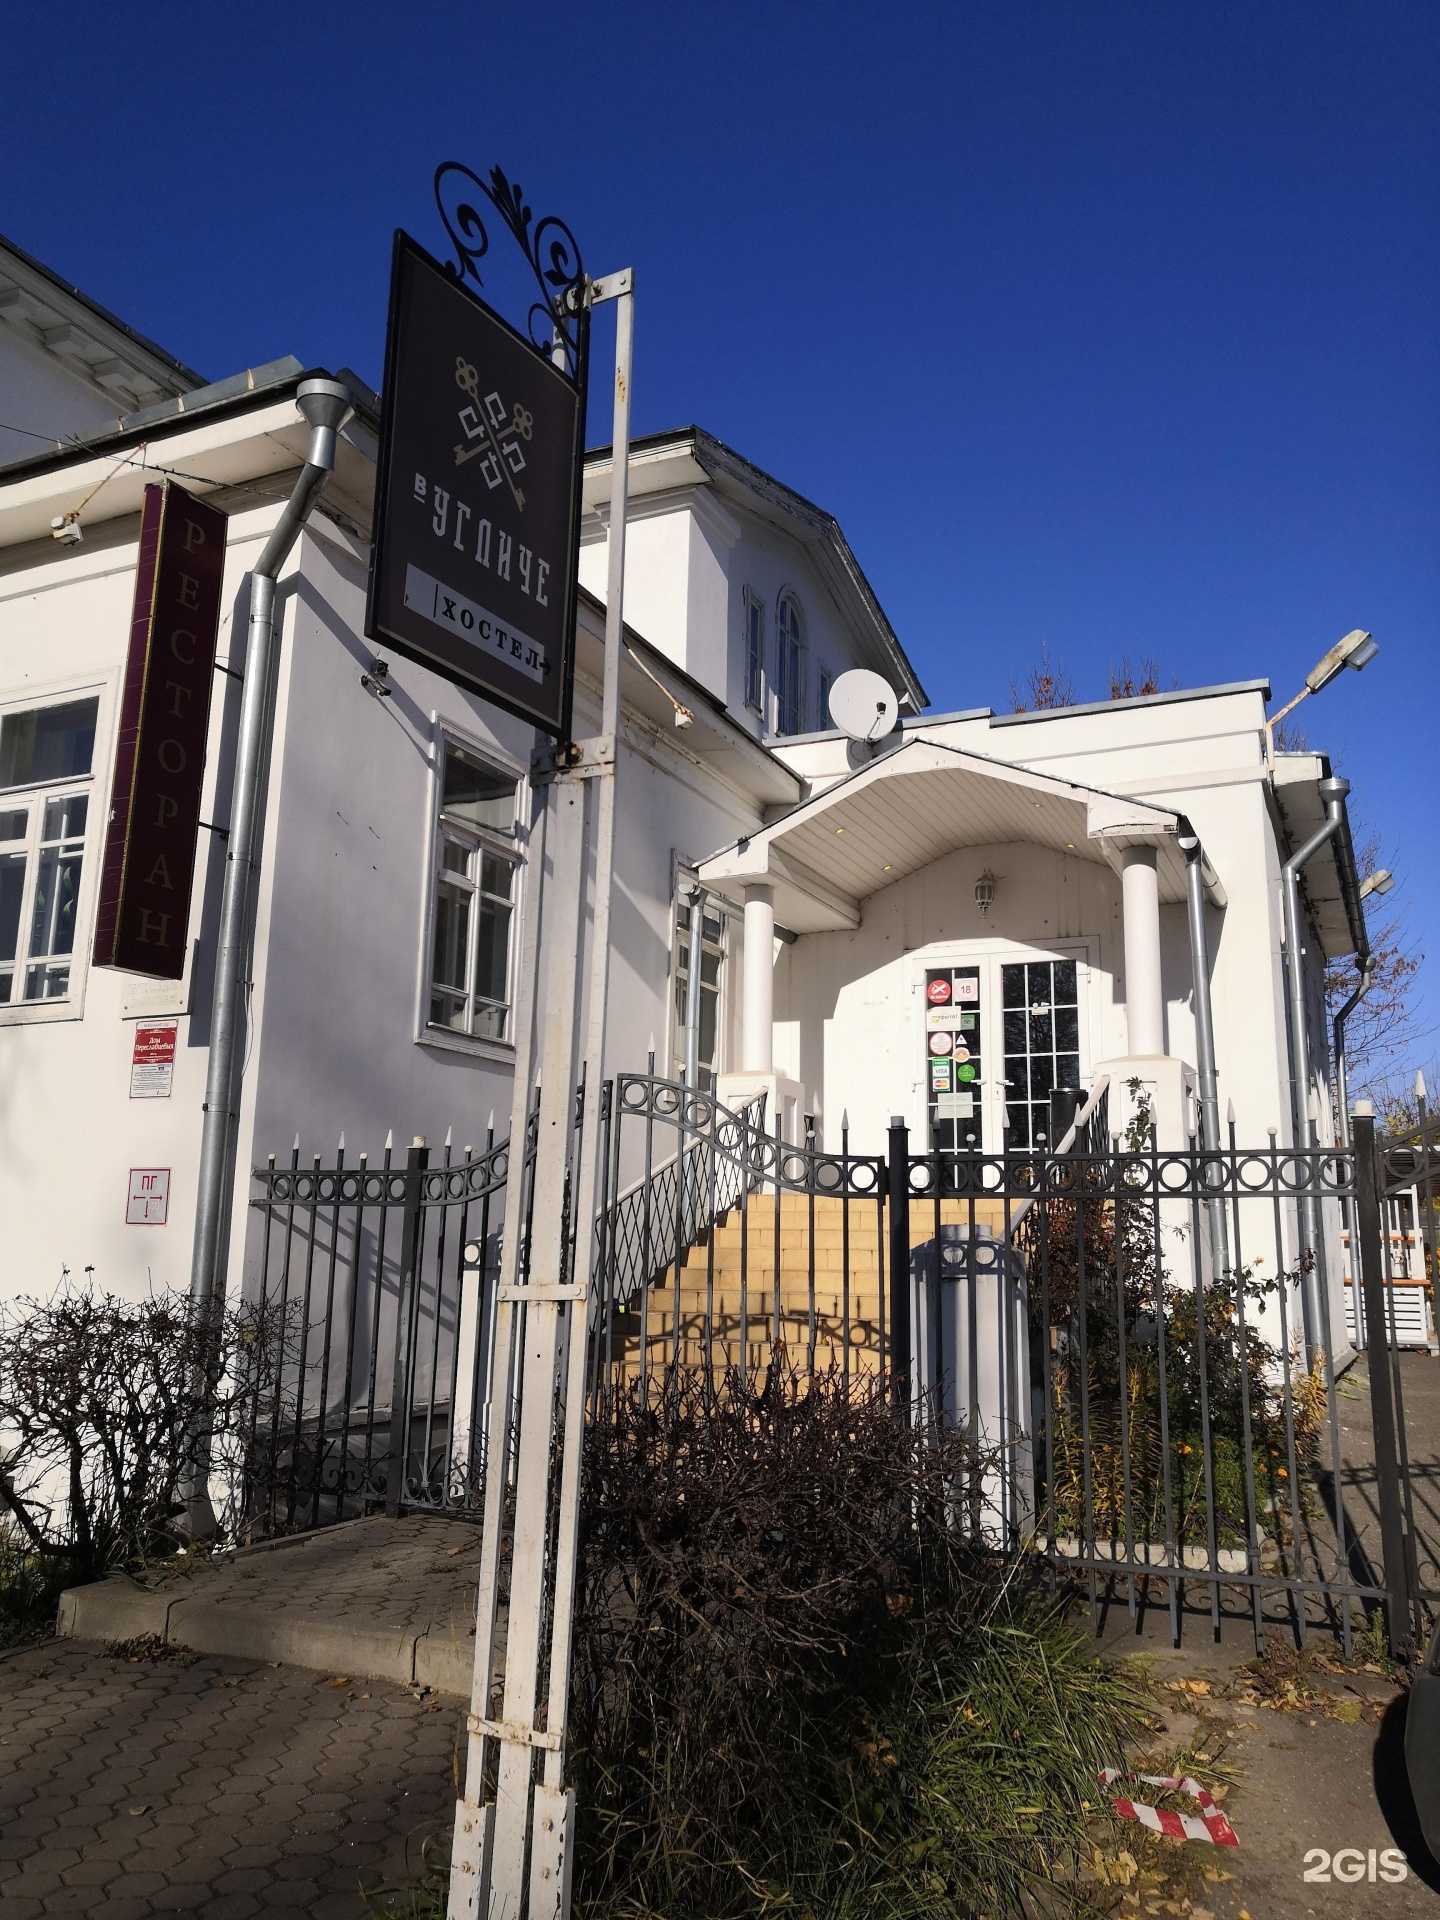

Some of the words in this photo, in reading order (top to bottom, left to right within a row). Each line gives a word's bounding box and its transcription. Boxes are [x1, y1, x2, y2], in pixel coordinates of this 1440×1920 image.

[432, 484, 551, 608] УГЛИЧЕ
[442, 595, 541, 671] ХОСТЕЛ
[135, 518, 208, 948] РЕСТОРАН
[142, 1175, 158, 1191] ПГ
